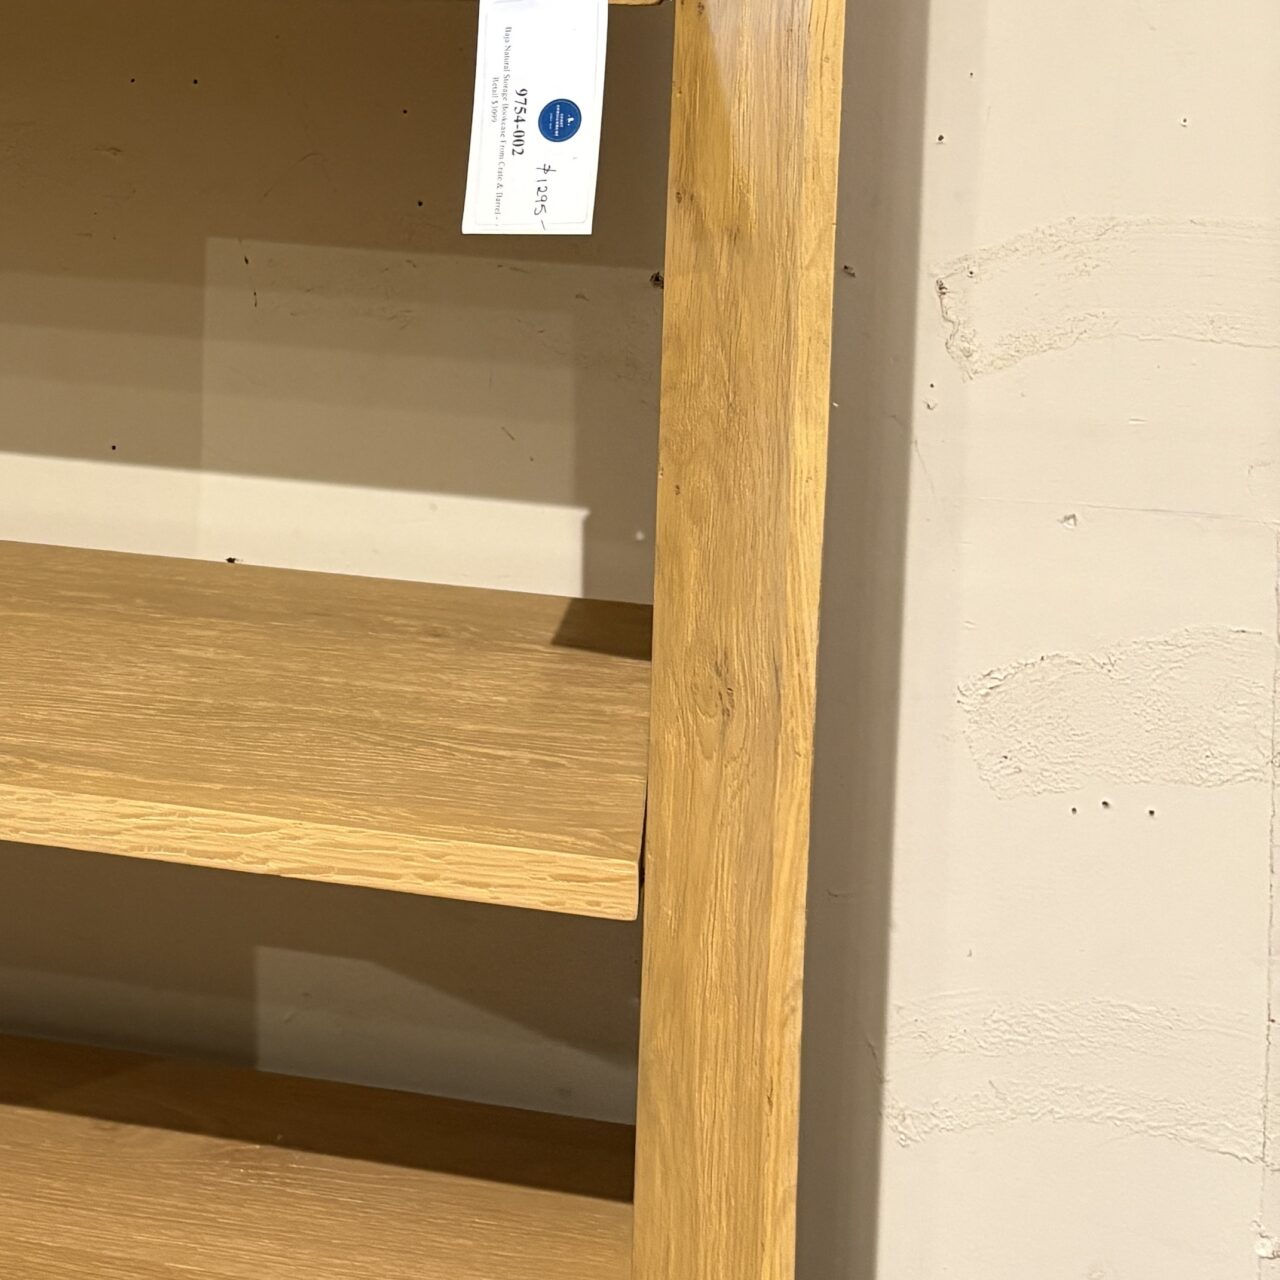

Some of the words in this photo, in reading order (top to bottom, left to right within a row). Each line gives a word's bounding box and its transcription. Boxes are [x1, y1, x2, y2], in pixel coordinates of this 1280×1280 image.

[503, 45, 512, 72] Natural
[491, 77, 500, 98] Retail
[501, 74, 511, 101] Storage
[500, 103, 509, 137] Bookcase
[512, 88, 528, 156] 9754-002
[498, 140, 507, 160] From
[497, 161, 506, 181] Crate
[494, 192, 503, 215] Barrel
